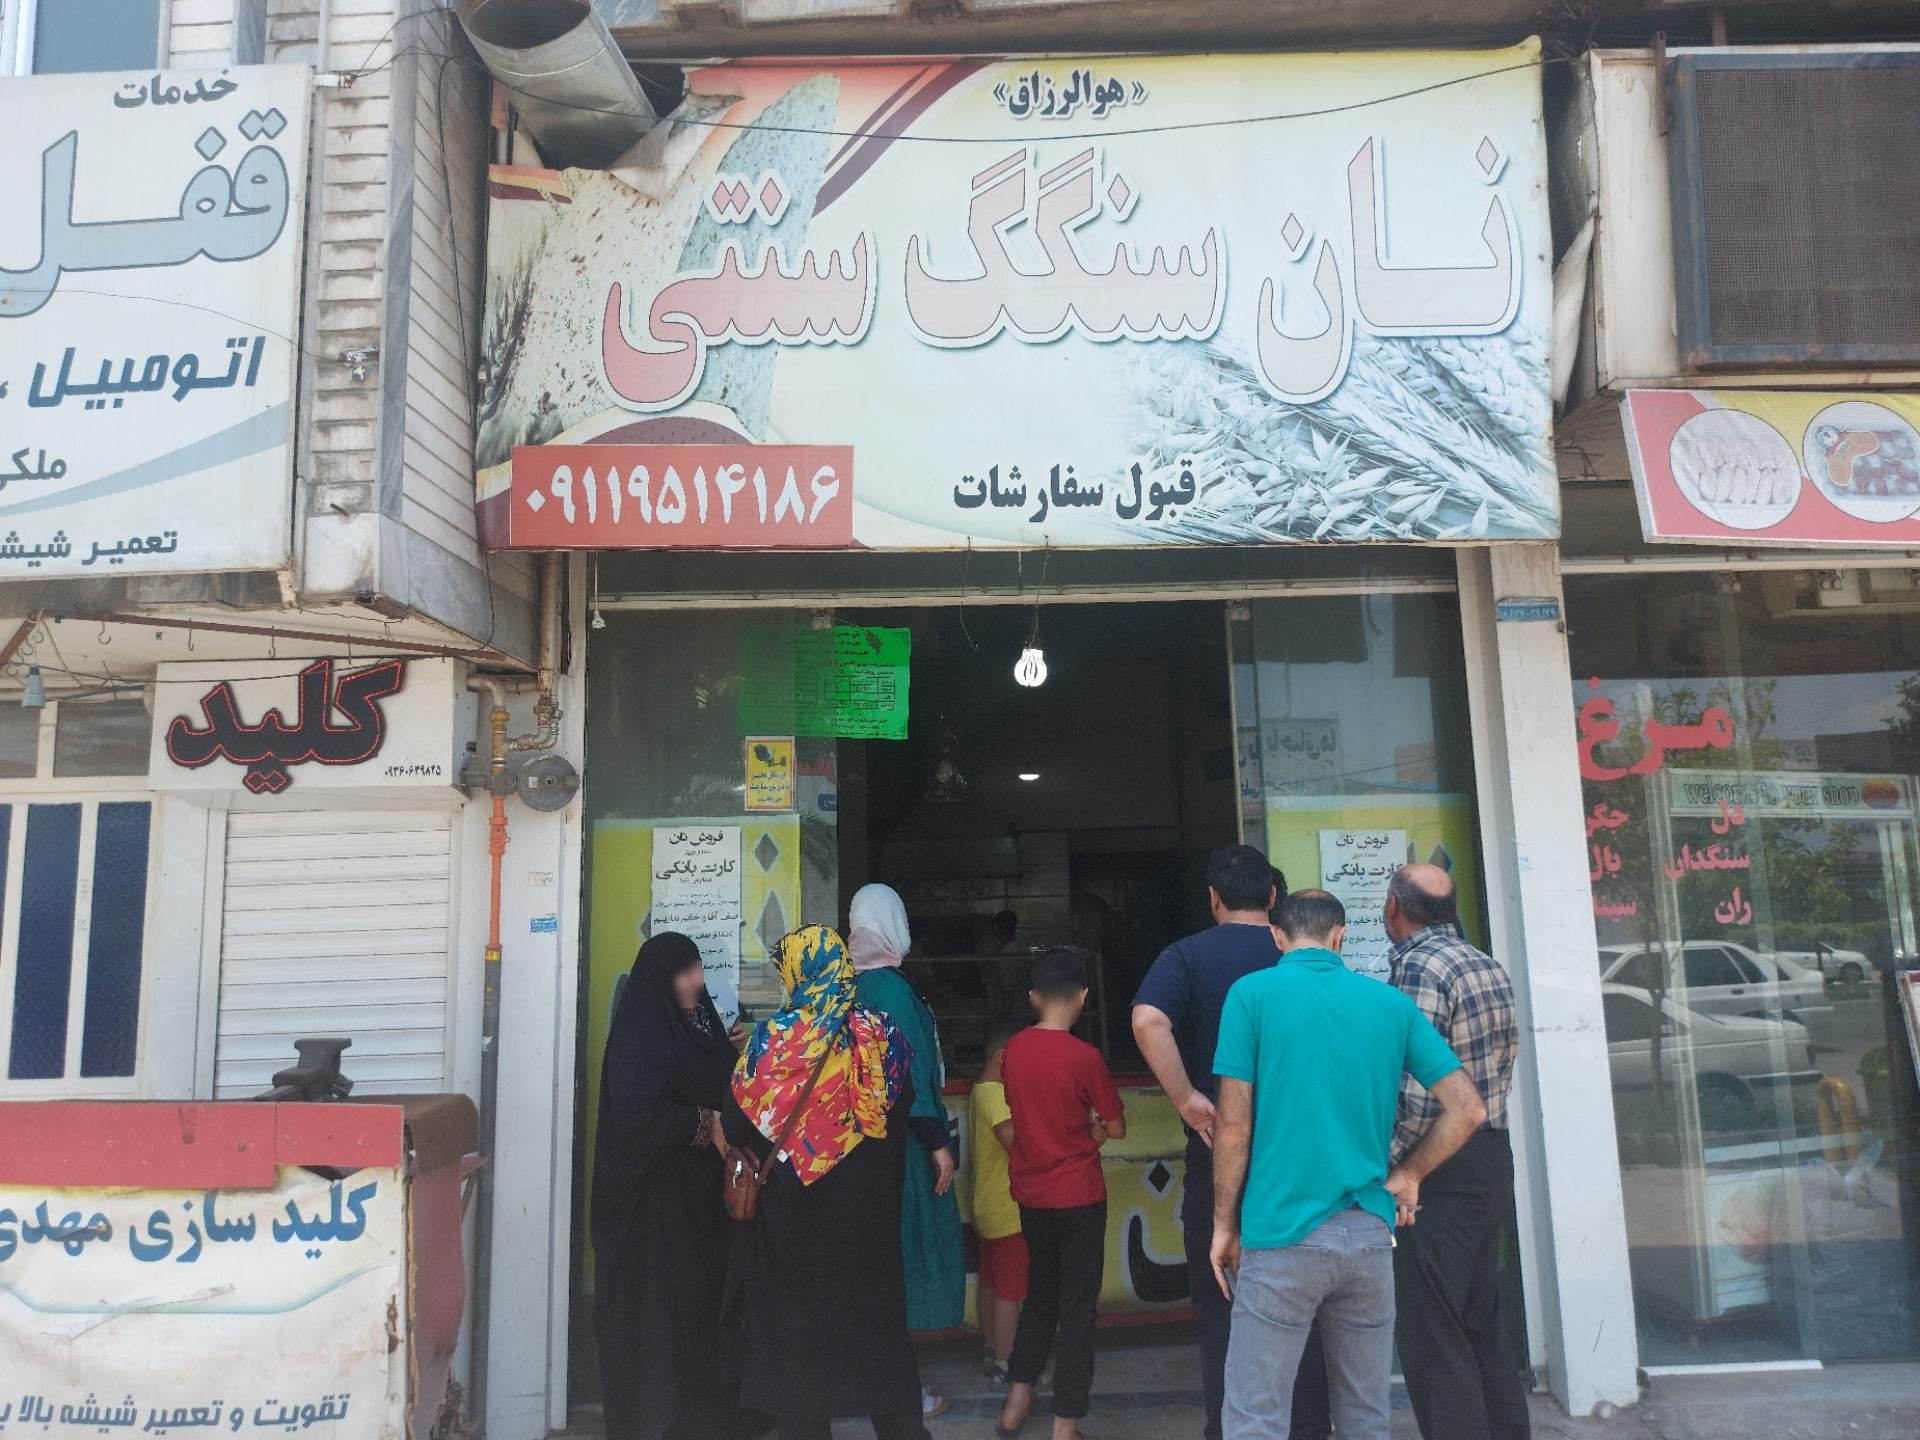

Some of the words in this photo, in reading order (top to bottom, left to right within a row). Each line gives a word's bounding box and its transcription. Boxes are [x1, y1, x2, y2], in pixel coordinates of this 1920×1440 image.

[114, 69, 240, 109] خدمات
[0, 108, 289, 319] قفل
[1256, 134, 1518, 398] نان
[600, 175, 871, 406] سنتی
[28, 335, 266, 410] اتومبیل
[525, 463, 841, 526] ۰۹۱۱۹۵۱۴۱۸۶
[953, 464, 1104, 523] سفارشات
[1116, 458, 1197, 522] قبول
[0, 529, 71, 567] شیش
[82, 529, 179, 565] تعمیر
[165, 656, 405, 793] کلید
[1578, 676, 1735, 781] مرغ
[1761, 781, 1778, 806] to
[1783, 784, 1819, 809] your
[1822, 778, 1860, 807] shop
[1710, 799, 1745, 835] دل
[669, 831, 688, 845] نان
[690, 830, 724, 847] فروش
[1335, 834, 1354, 847] نان
[1356, 833, 1390, 849] فروش
[655, 860, 698, 880] بانکی
[700, 858, 736, 877] کارت
[1325, 862, 1366, 882] بانکی
[1589, 843, 1622, 881] بال
[1663, 843, 1751, 880] سنگدان
[1713, 886, 1753, 925] ران
[129, 1188, 257, 1263] سازی
[272, 1180, 378, 1259] کلید
[18, 1395, 54, 1431] بالا
[60, 1393, 138, 1434] شیشه
[143, 1399, 224, 1435] تعمیر
[229, 1406, 245, 1432] و
[253, 1393, 351, 1432] تقویت
